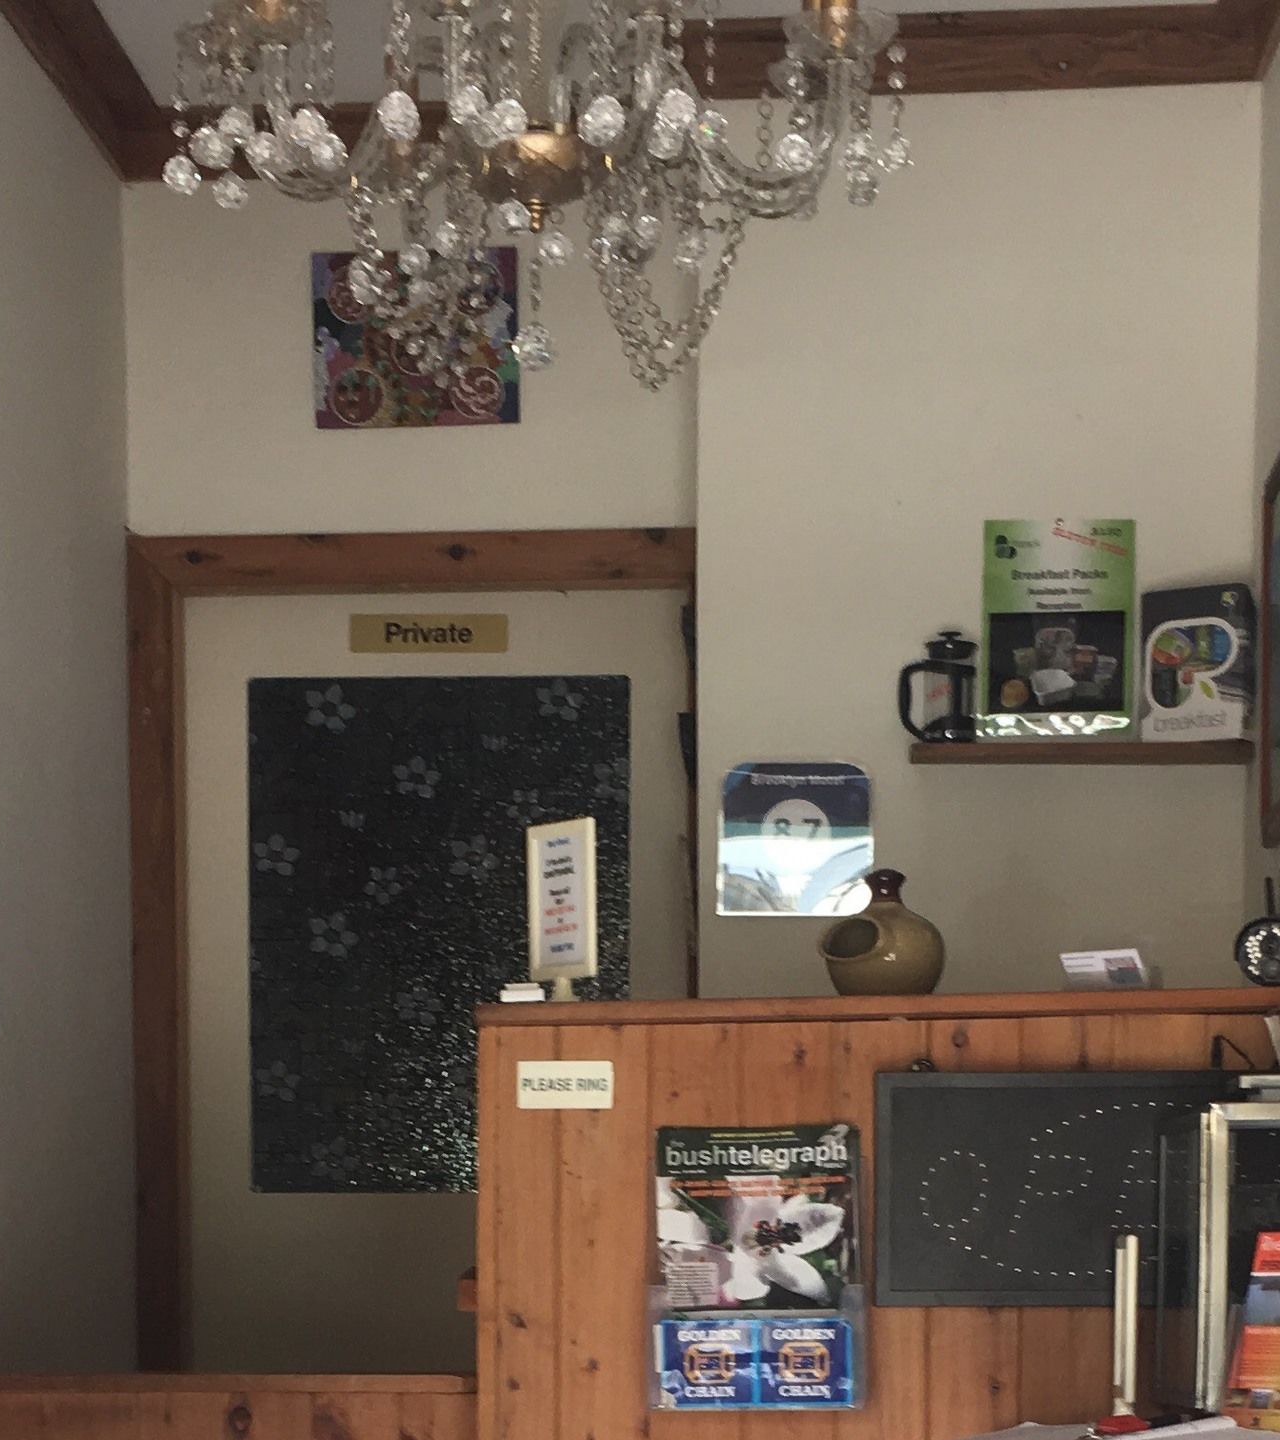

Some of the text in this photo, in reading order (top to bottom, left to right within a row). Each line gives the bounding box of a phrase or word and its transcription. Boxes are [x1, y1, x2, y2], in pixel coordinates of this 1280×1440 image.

[384, 622, 473, 644] Private
[521, 1078, 609, 1092] PLEASE RING
[665, 1142, 848, 1170] bushtelegraph
[677, 1329, 741, 1342] GOLDEN
[772, 1328, 836, 1340] GOLDEN
[684, 1386, 736, 1398] CHAIN
[778, 1385, 831, 1398] CHAIN
